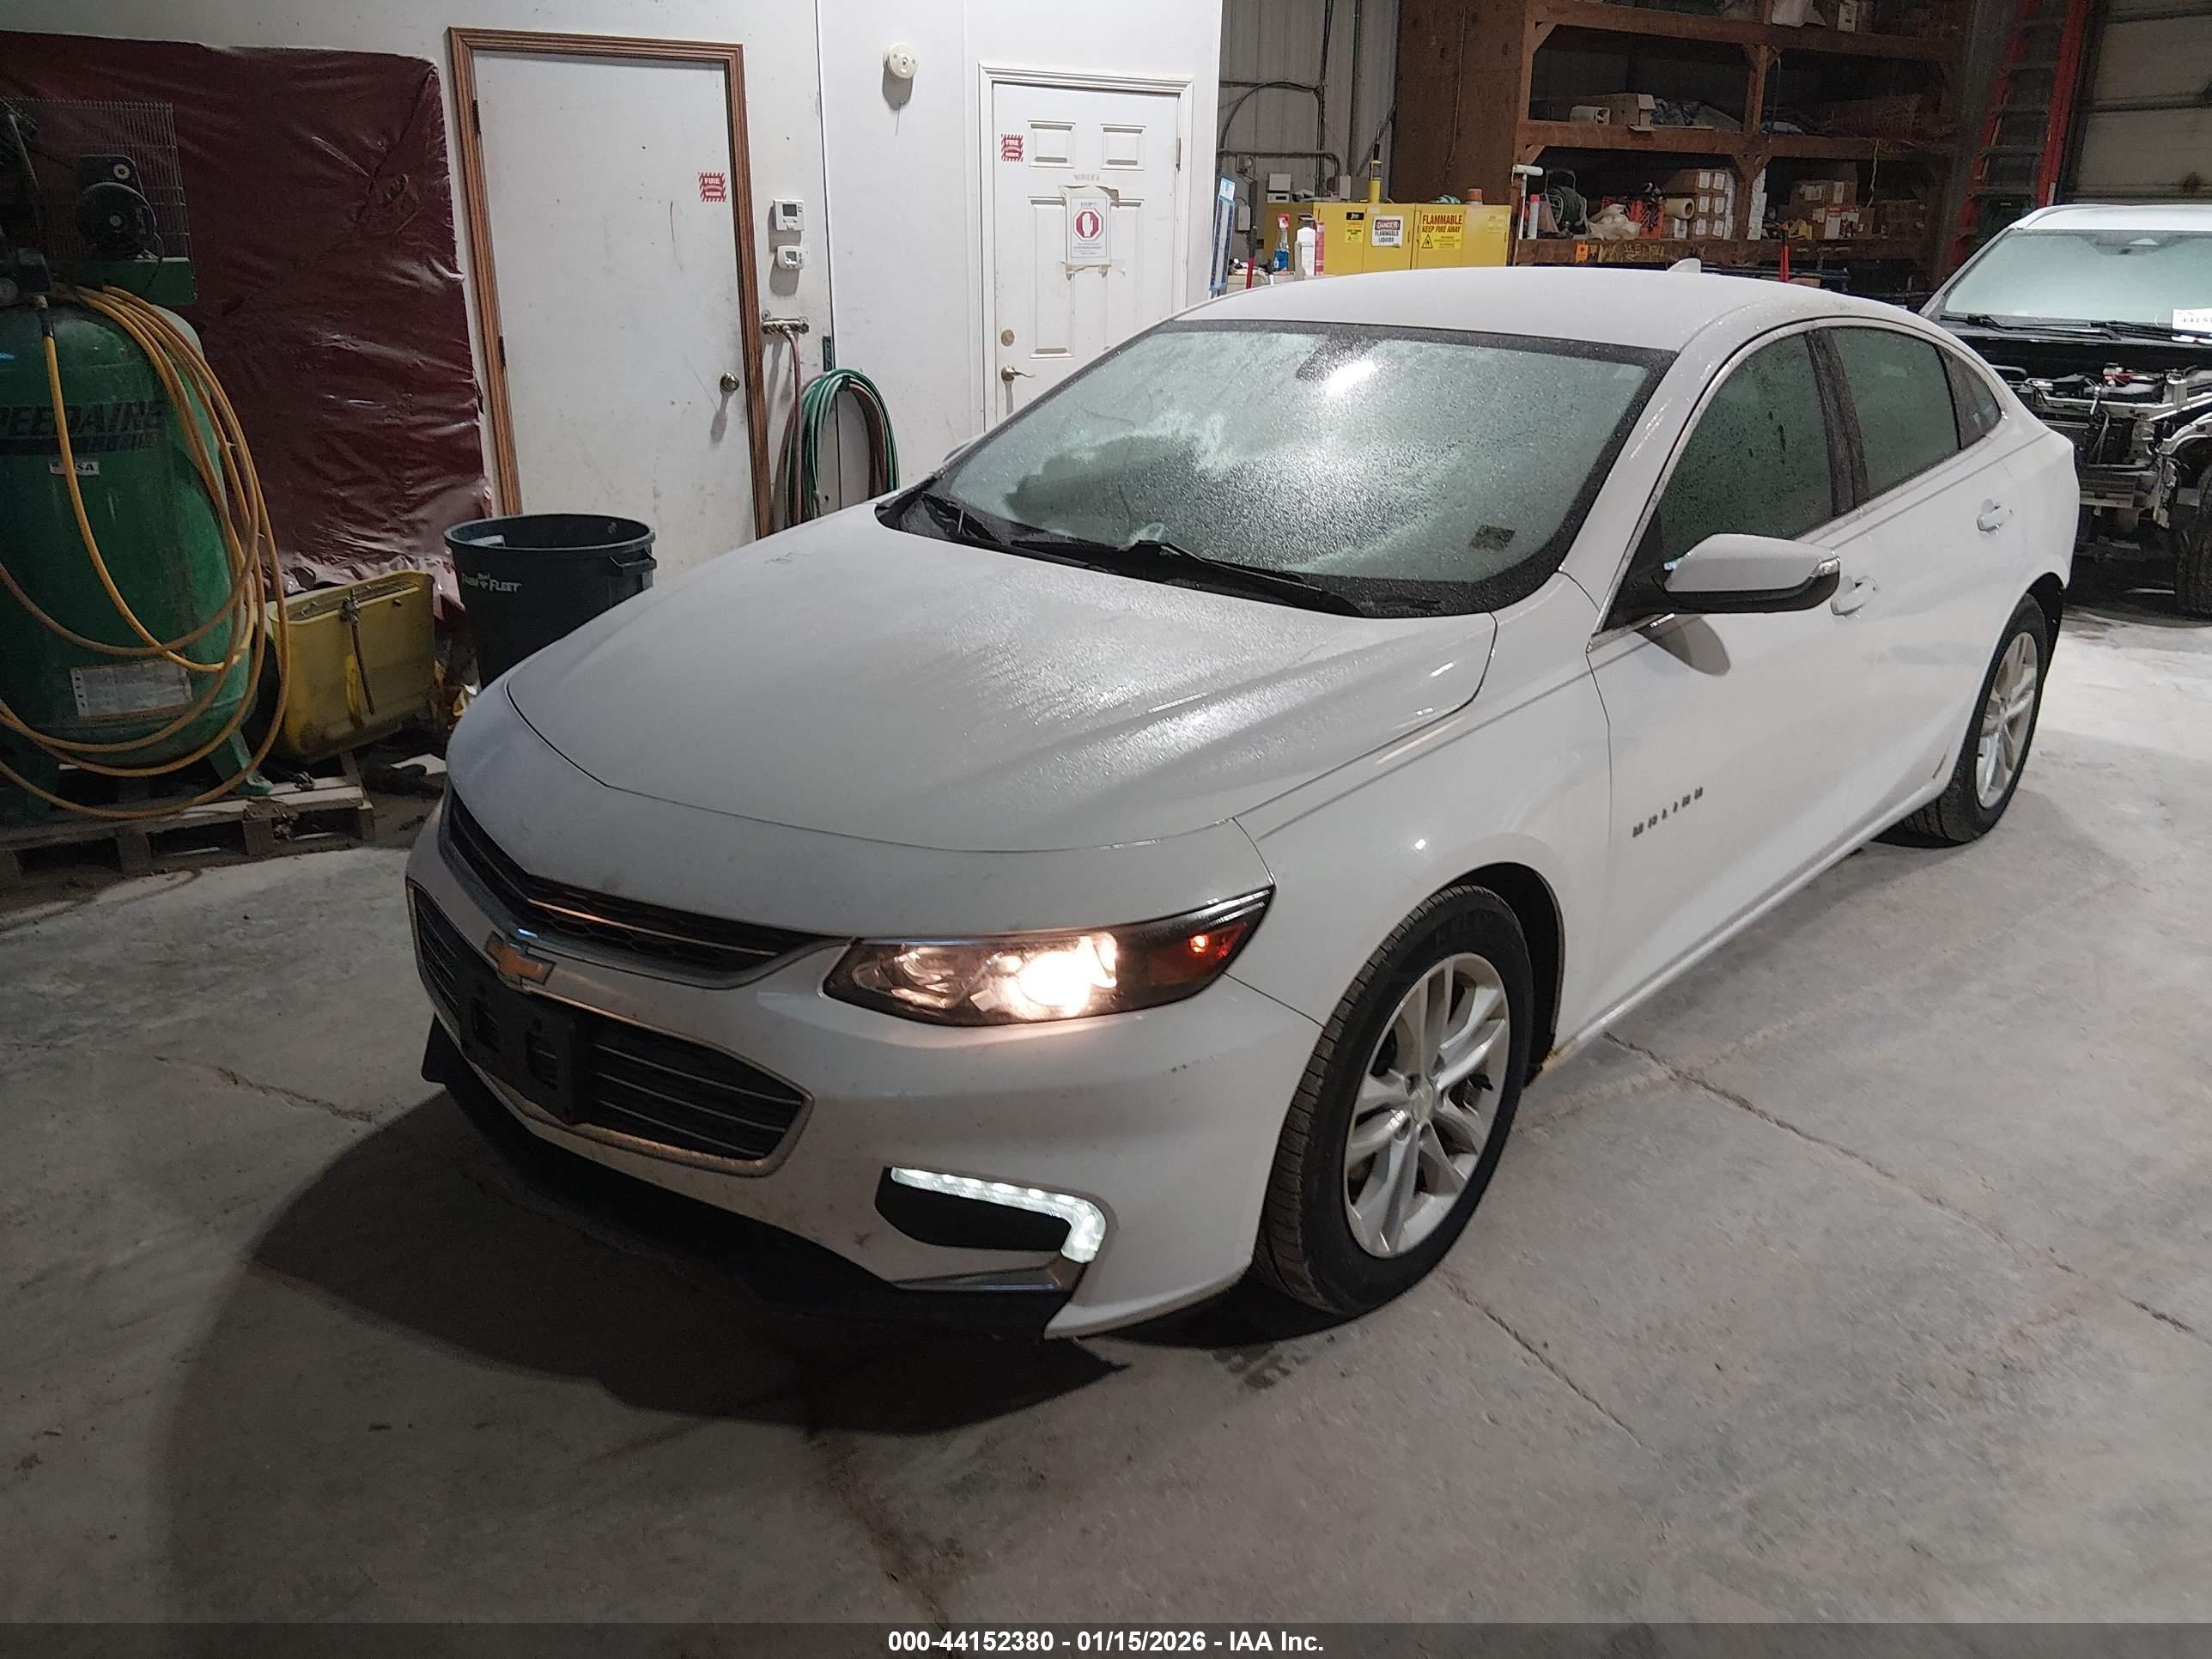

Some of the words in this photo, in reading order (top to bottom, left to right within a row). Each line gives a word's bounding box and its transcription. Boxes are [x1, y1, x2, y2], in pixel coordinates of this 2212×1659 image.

[1422, 215, 1462, 224] FLAMMABLE
[1376, 221, 1398, 229] DANGER
[489, 579, 520, 592] FLEET
